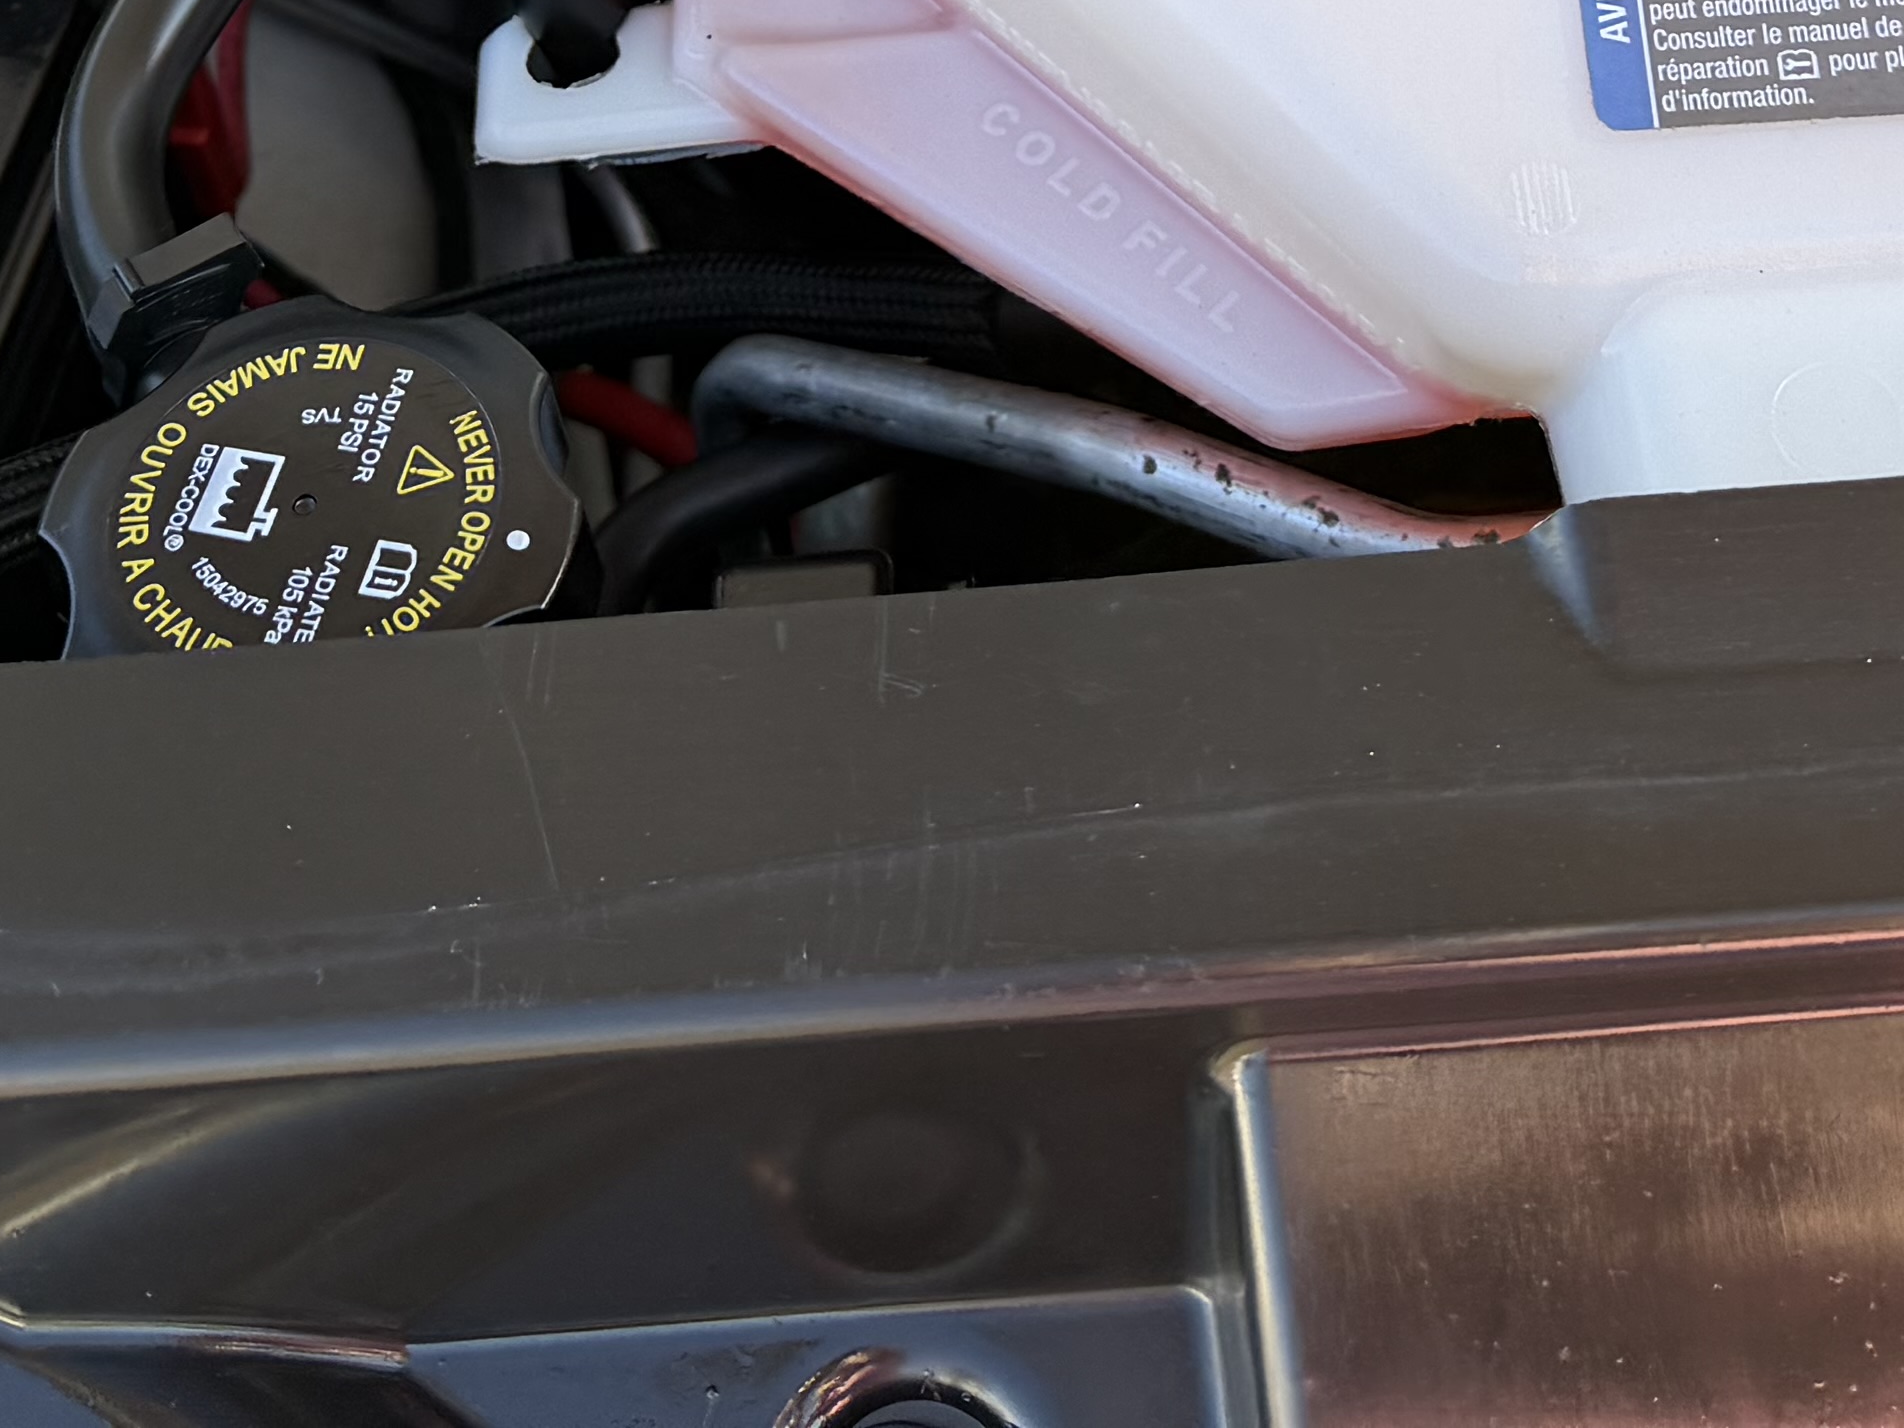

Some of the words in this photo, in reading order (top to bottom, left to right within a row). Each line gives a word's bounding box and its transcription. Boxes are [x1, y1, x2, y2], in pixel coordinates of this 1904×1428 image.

[1649, 0, 1698, 25] peut
[1653, 24, 1757, 52] Consulter
[1762, 23, 1782, 46] le
[1788, 17, 1869, 43] manuel
[1875, 16, 1903, 38] de
[1657, 58, 1769, 84] réparation
[1828, 51, 1881, 77] pour
[1661, 87, 1815, 113] d'information.
[981, 102, 1122, 222] COLD
[1122, 219, 1241, 334] FILL
[313, 342, 365, 371] NE
[186, 345, 307, 418] JAMAIS
[301, 407, 342, 425] TVS
[357, 391, 379, 415] 15
[337, 417, 370, 453] PSI
[352, 367, 414, 483] RADIATOR
[449, 409, 497, 506] NEVER
[116, 421, 187, 550] OUVRIR
[441, 510, 492, 593] OPEN
[122, 558, 155, 583] A
[191, 556, 270, 616] 15042975
[282, 566, 314, 604] 105
[263, 605, 299, 645] kPa
